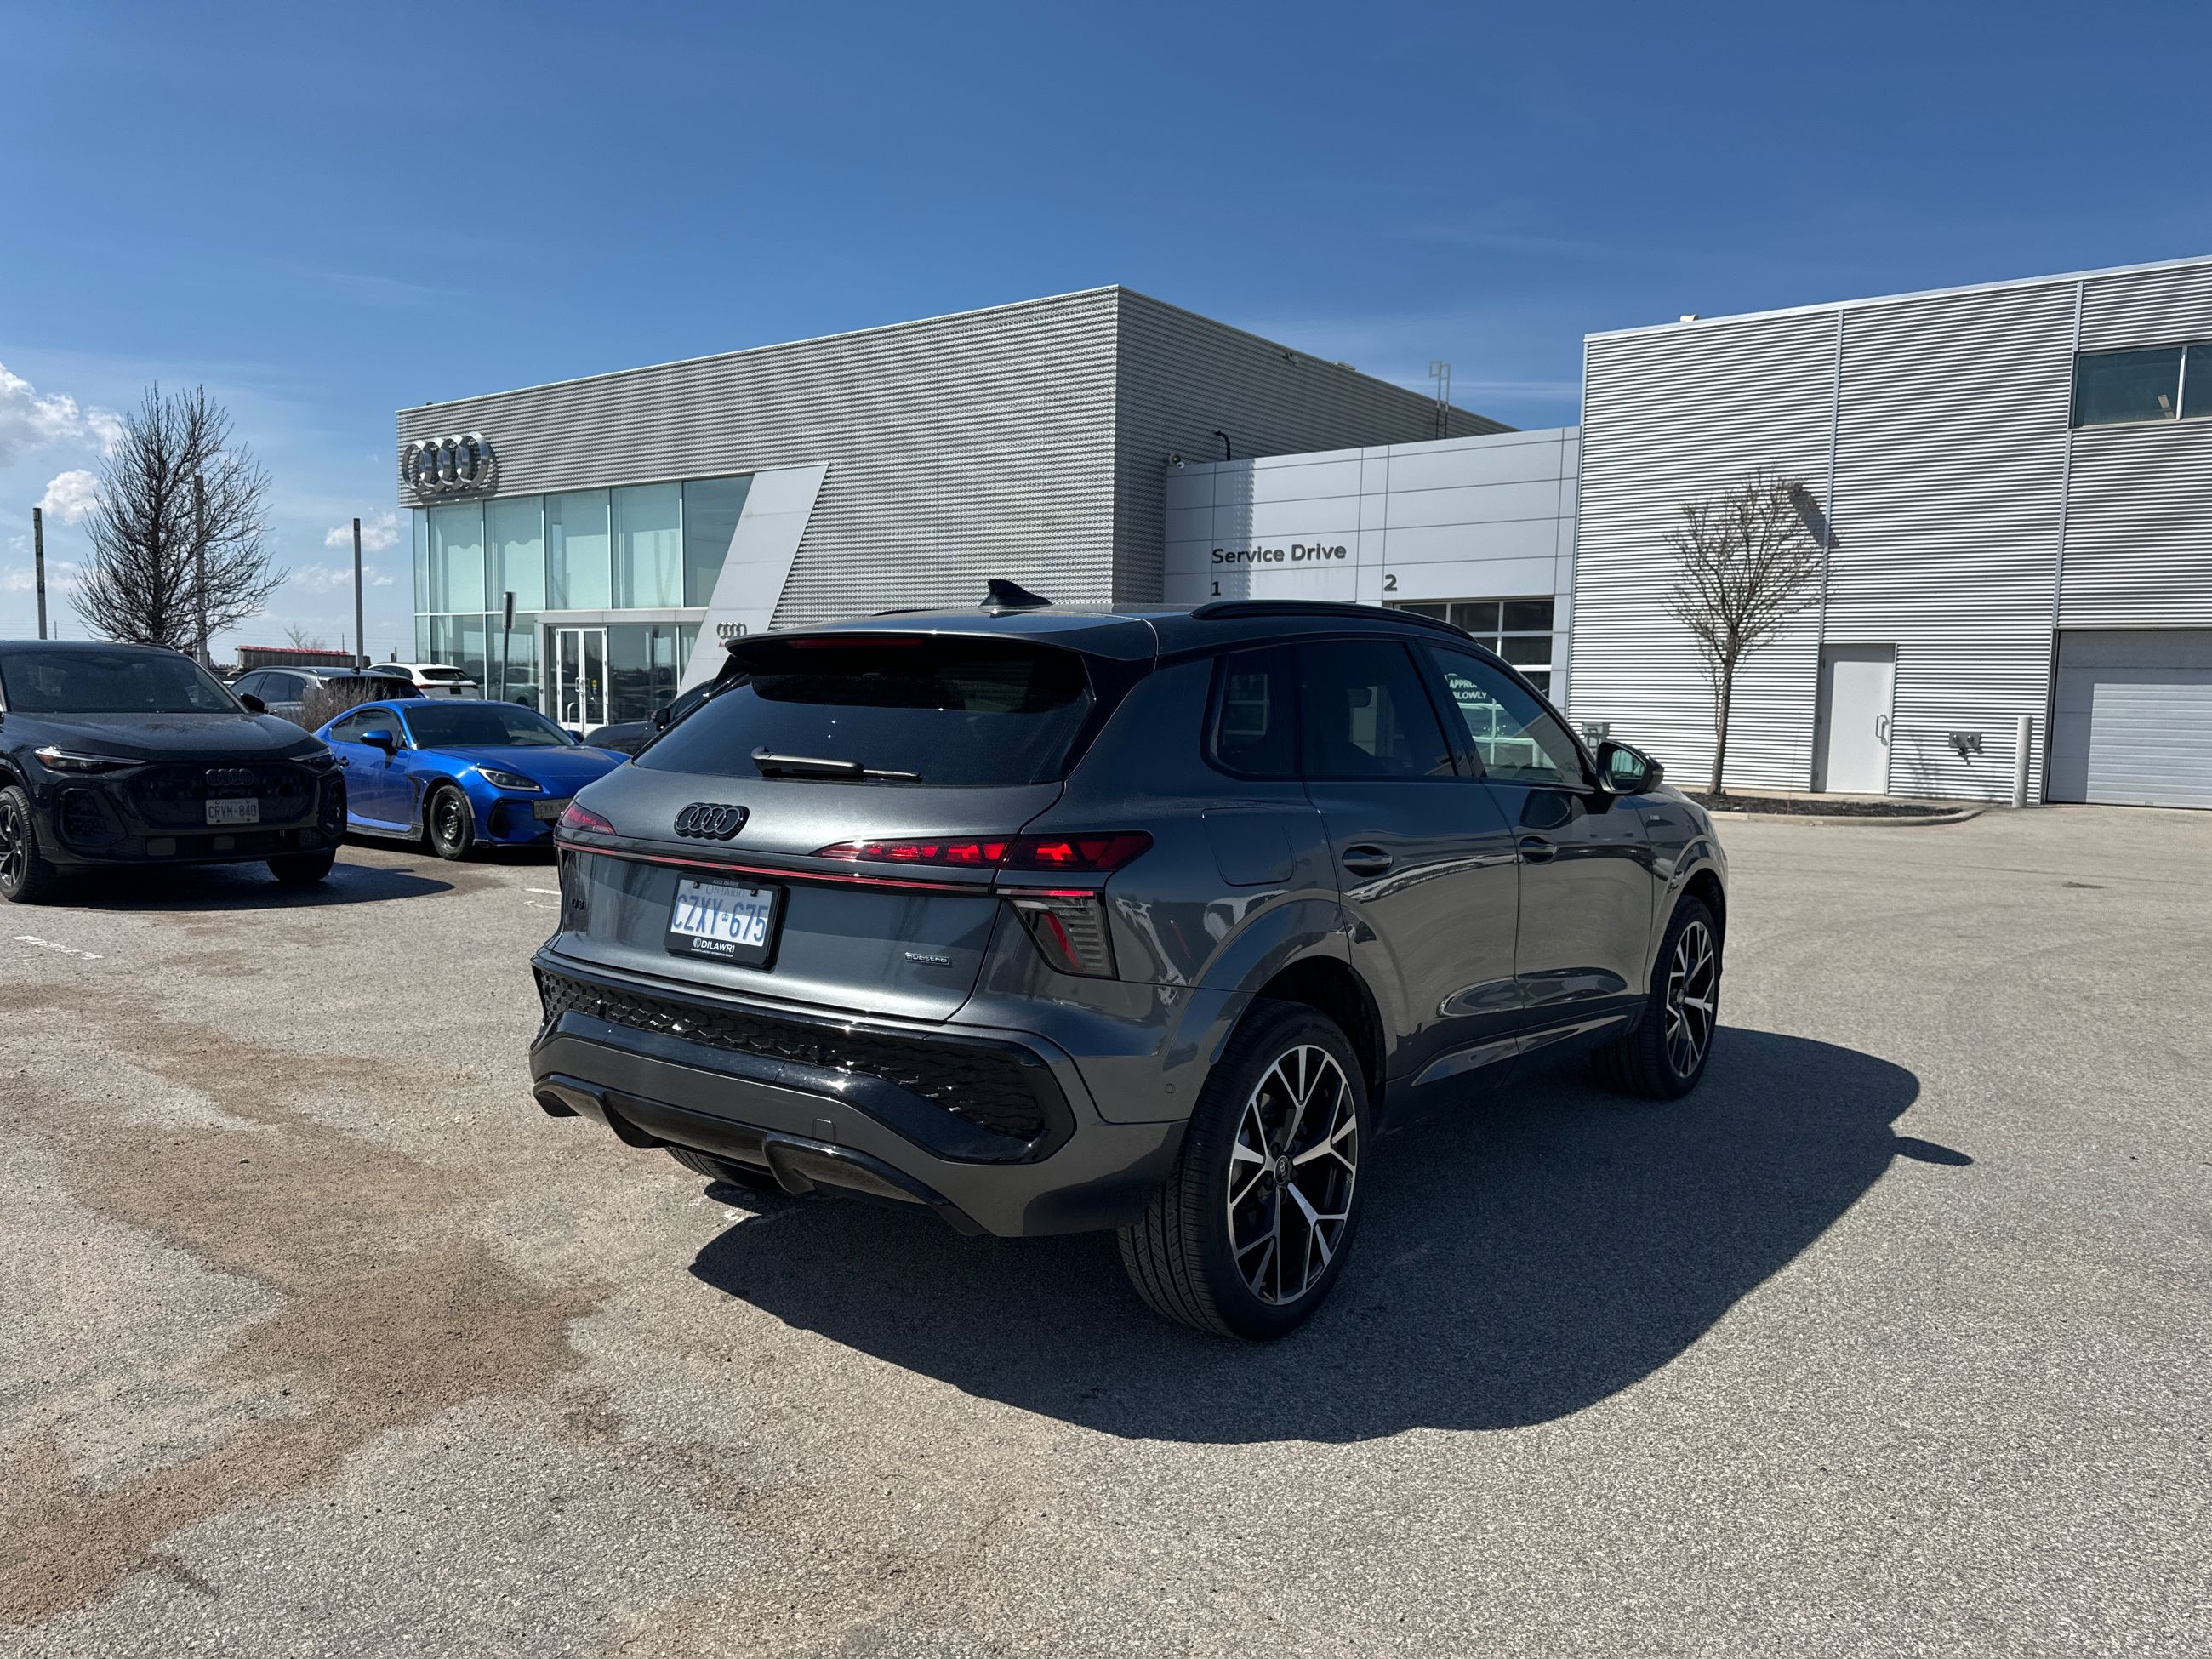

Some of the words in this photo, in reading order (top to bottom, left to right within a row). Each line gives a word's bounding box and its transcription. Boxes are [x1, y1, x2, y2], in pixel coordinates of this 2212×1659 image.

[1211, 546, 1285, 563] Service
[1291, 543, 1347, 562] Drive
[1211, 581, 1222, 596] 1
[1384, 573, 1398, 591] 2
[1449, 679, 1478, 688] APPR
[701, 939, 735, 953] DILAWRI
